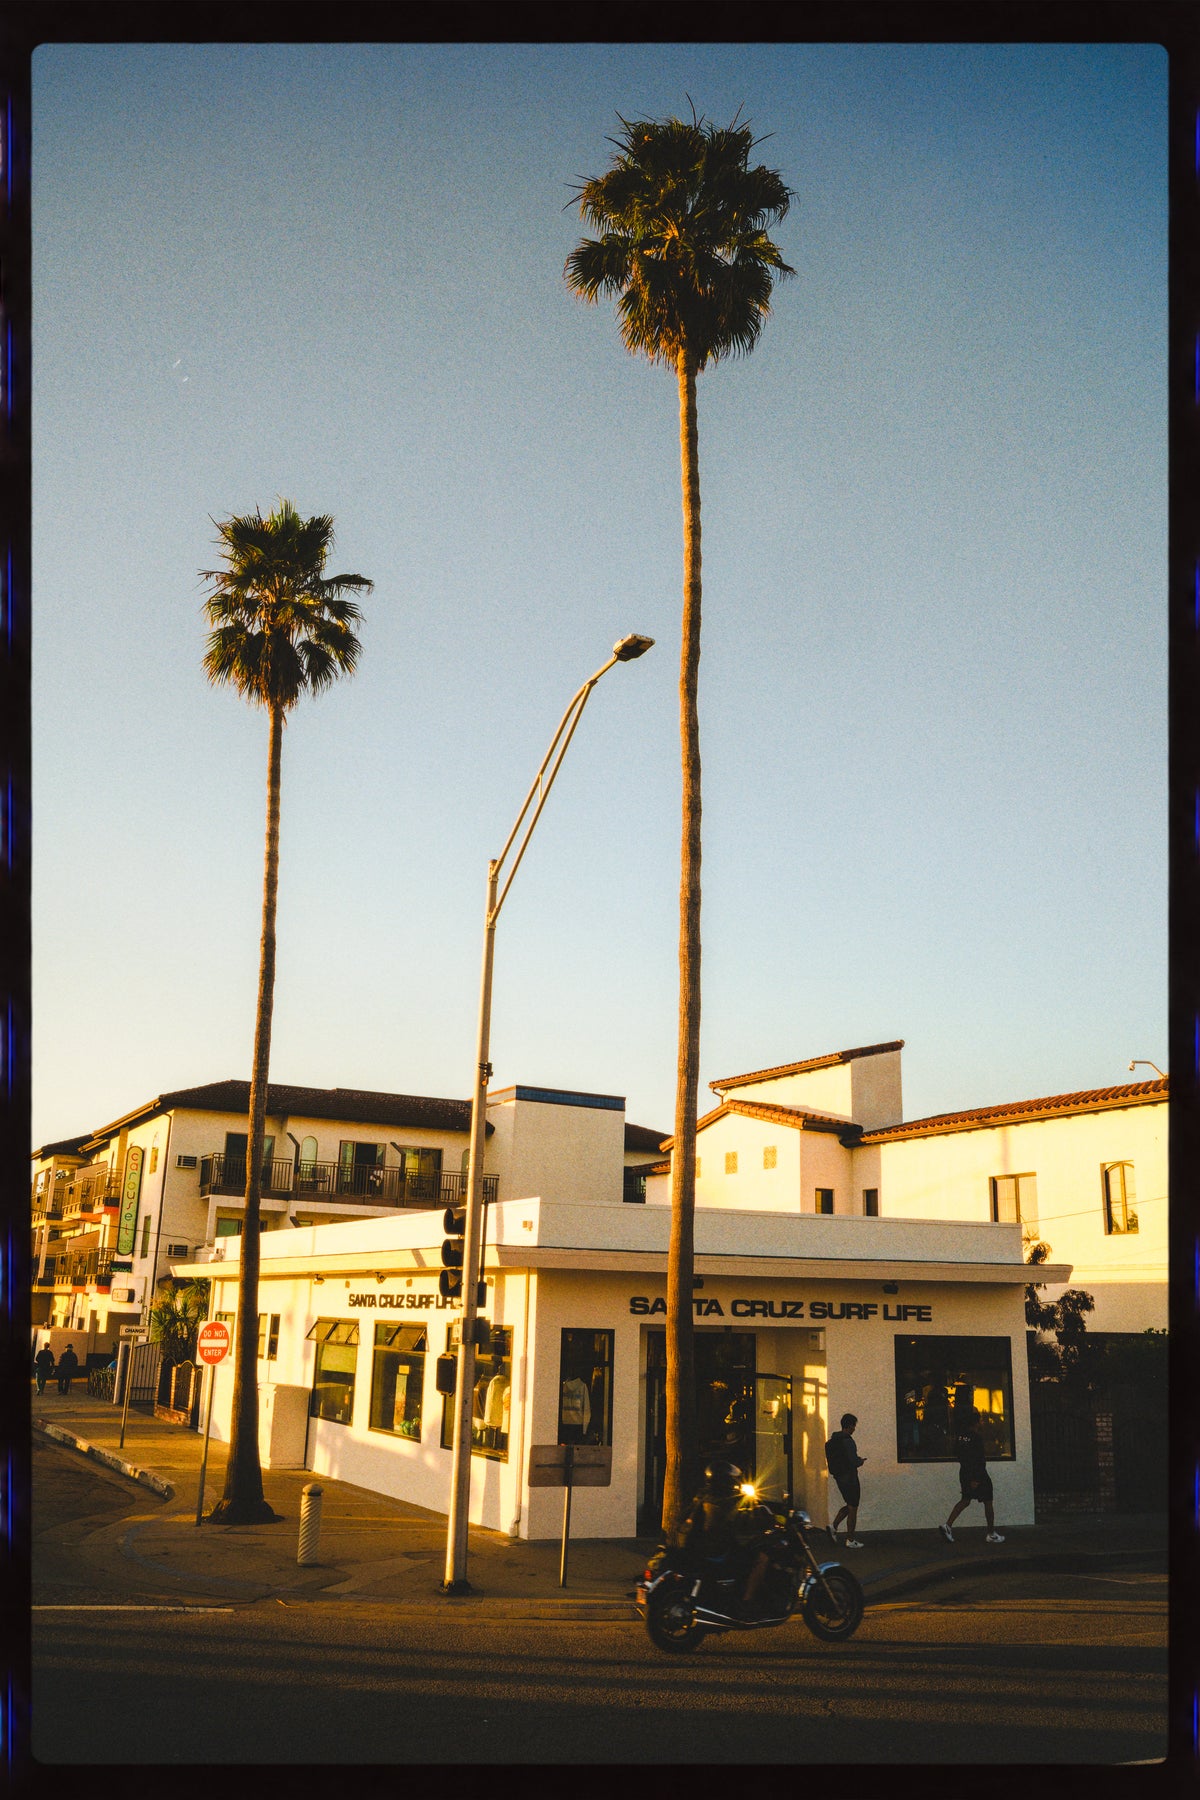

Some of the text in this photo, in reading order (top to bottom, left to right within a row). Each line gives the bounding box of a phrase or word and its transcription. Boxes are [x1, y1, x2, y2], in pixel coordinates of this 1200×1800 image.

[348, 1293, 377, 1308] SANTA
[379, 1294, 405, 1309] CRUZ
[406, 1294, 434, 1309] SURF
[629, 1296, 932, 1322] SATA CRUZ SURF LIFE
[203, 1330, 226, 1338] DO NOT
[203, 1349, 222, 1357] ENTER
